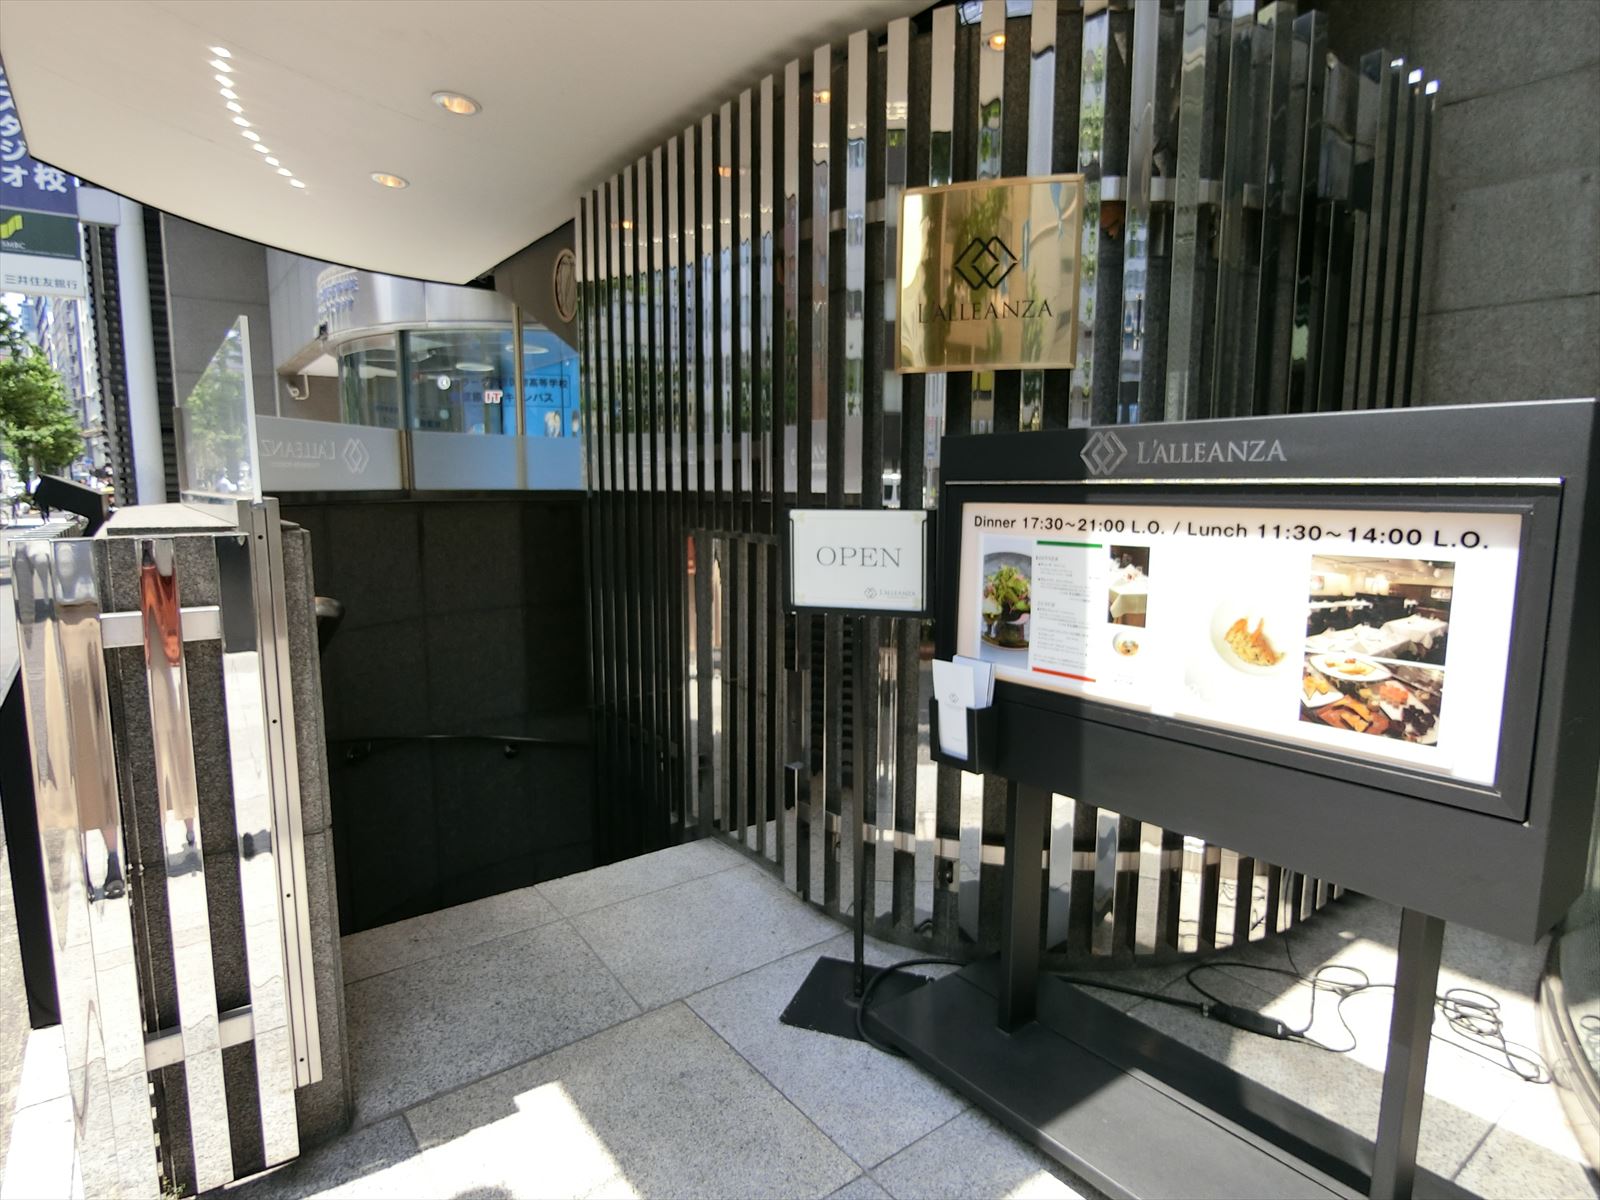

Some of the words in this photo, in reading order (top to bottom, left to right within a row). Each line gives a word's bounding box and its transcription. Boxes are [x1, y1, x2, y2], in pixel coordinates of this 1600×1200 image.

[33, 163, 68, 195] 校
[4, 273, 78, 290] 三井住友銀行
[1137, 439, 1288, 465] L'ALLEANZA
[974, 515, 1017, 529] Dinner
[1131, 520, 1165, 535] L.O.
[1187, 522, 1248, 538] Lunch
[1433, 530, 1489, 549] L.O.
[816, 546, 904, 568] OPEN
